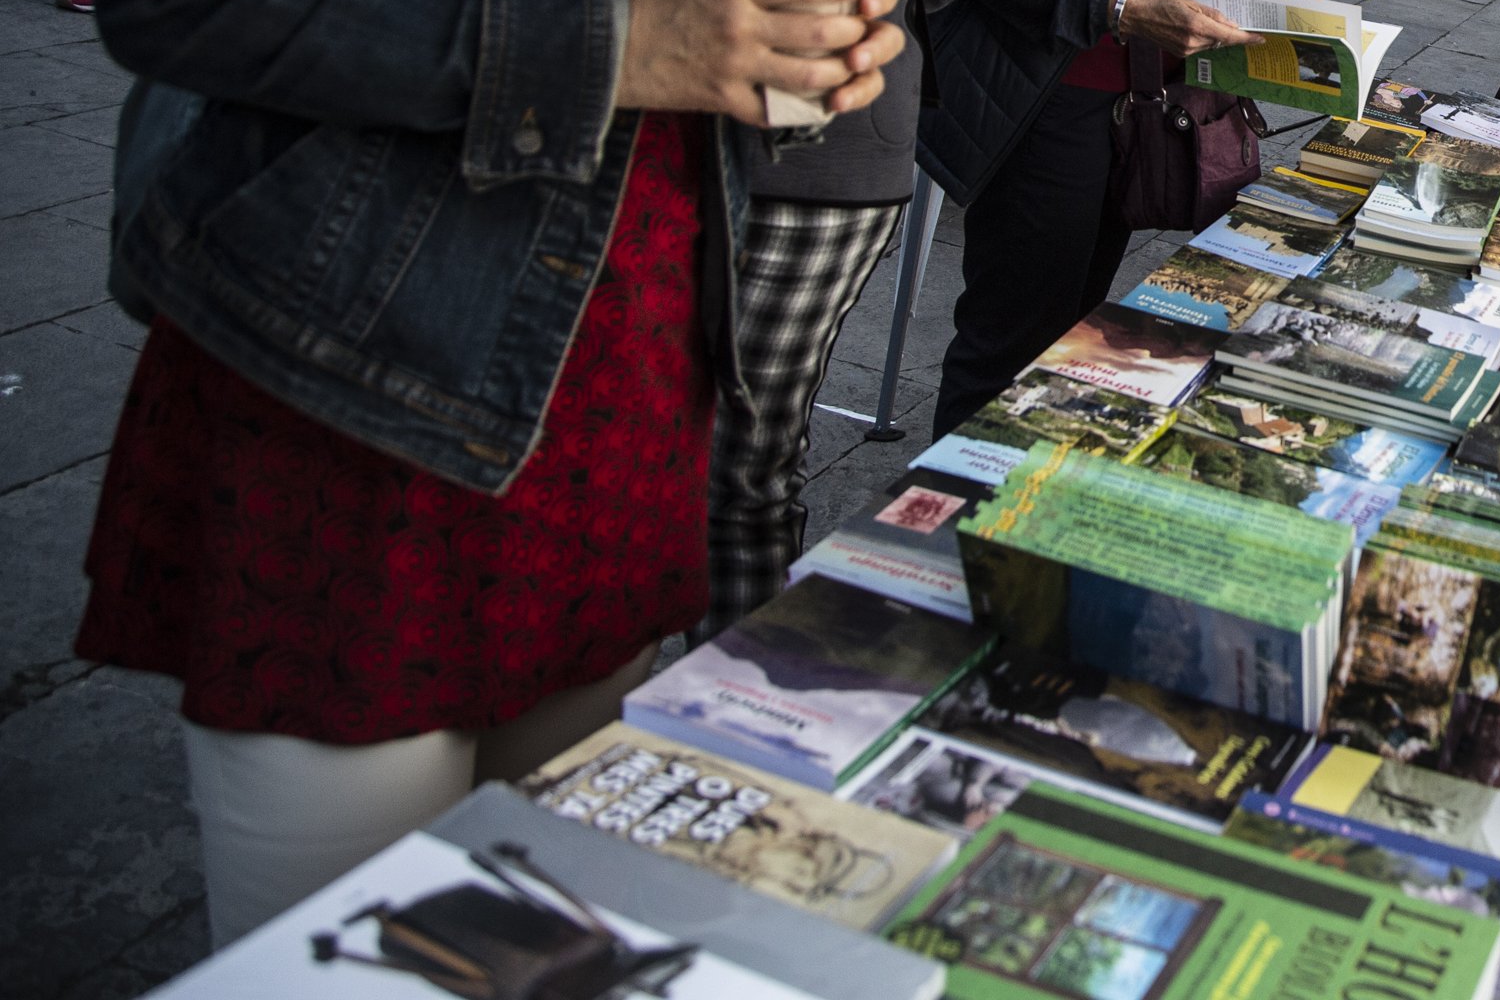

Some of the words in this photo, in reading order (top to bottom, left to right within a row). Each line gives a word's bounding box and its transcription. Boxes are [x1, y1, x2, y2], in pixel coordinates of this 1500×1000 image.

[1137, 293, 1213, 322] Montserrat
[1055, 365, 1153, 399] Pedraforca
[1063, 358, 1118, 379] màgic
[846, 555, 957, 593] Serrallonga
[695, 774, 733, 799] O
[629, 796, 710, 847] TRES
[691, 784, 773, 844] DUES
[1341, 902, 1464, 1000] L'HO
